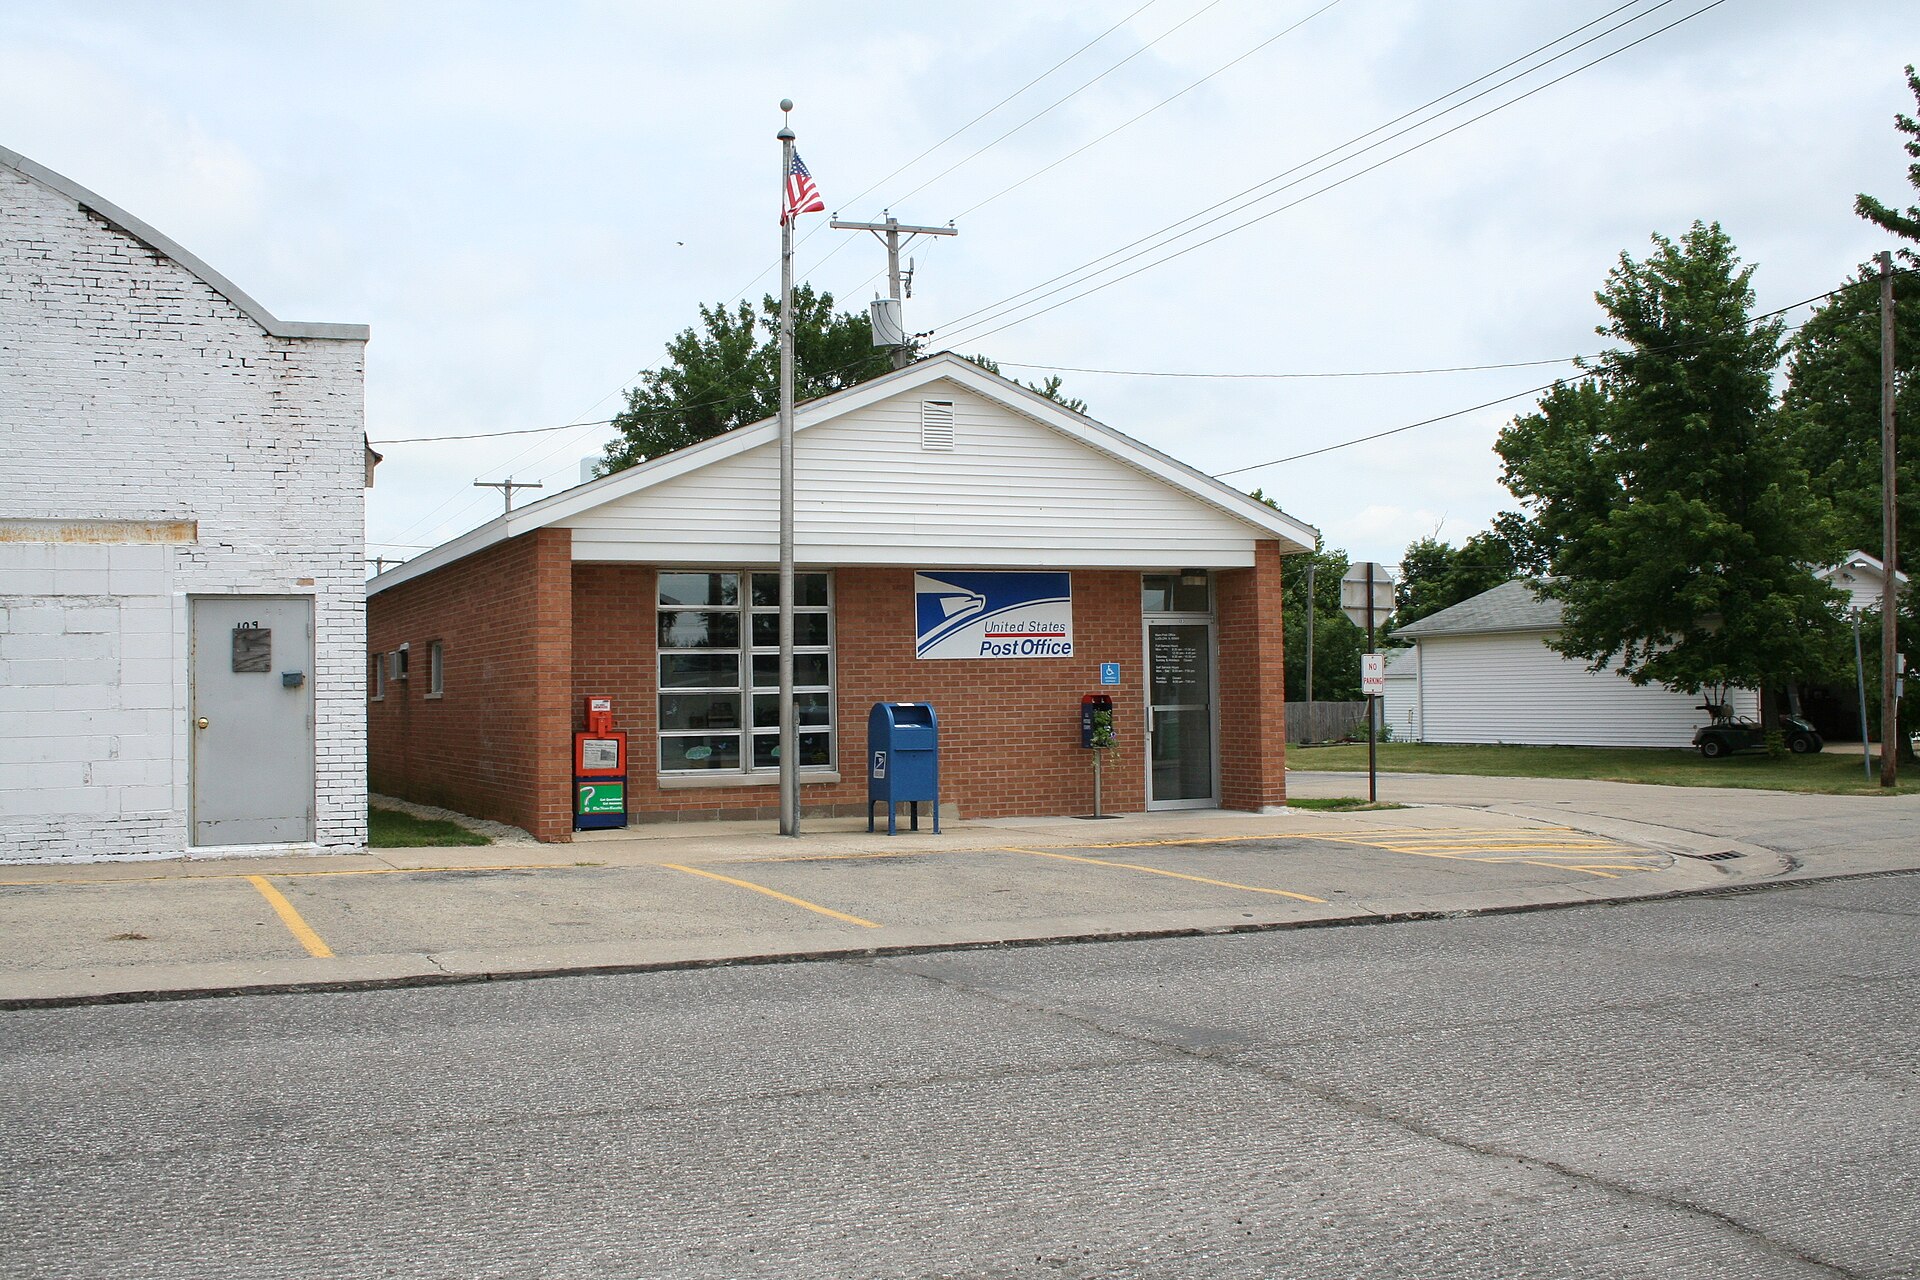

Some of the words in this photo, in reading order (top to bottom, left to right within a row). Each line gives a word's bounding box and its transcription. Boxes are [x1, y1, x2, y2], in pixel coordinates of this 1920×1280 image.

[984, 620, 1025, 633] United
[1028, 620, 1066, 632] States
[979, 640, 1019, 656] Post
[1021, 638, 1072, 656] Office
